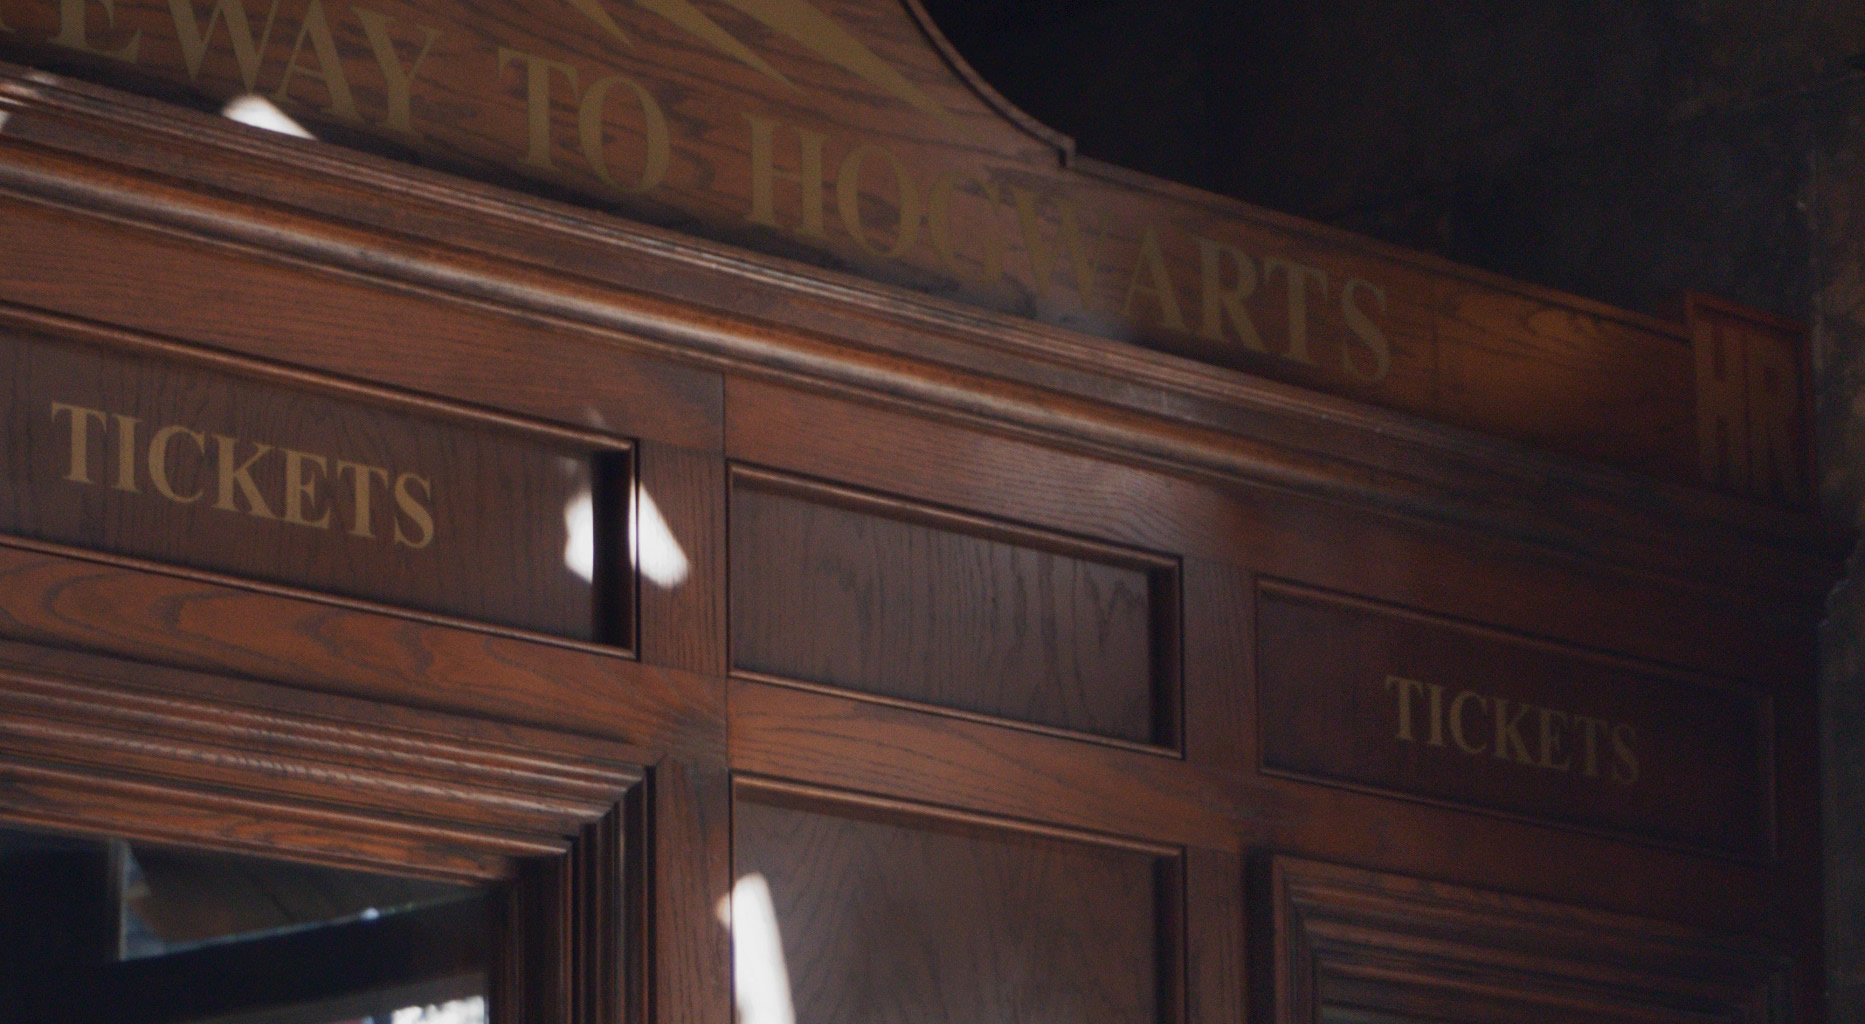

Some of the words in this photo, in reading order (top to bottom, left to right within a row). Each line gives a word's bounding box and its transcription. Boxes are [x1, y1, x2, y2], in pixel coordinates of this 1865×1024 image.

[0, 0, 444, 140] EWAY
[497, 45, 670, 195] TO
[741, 111, 1393, 386] HOGWARTS
[50, 401, 435, 549] TICKETS
[1385, 673, 1641, 787] TICKETS
